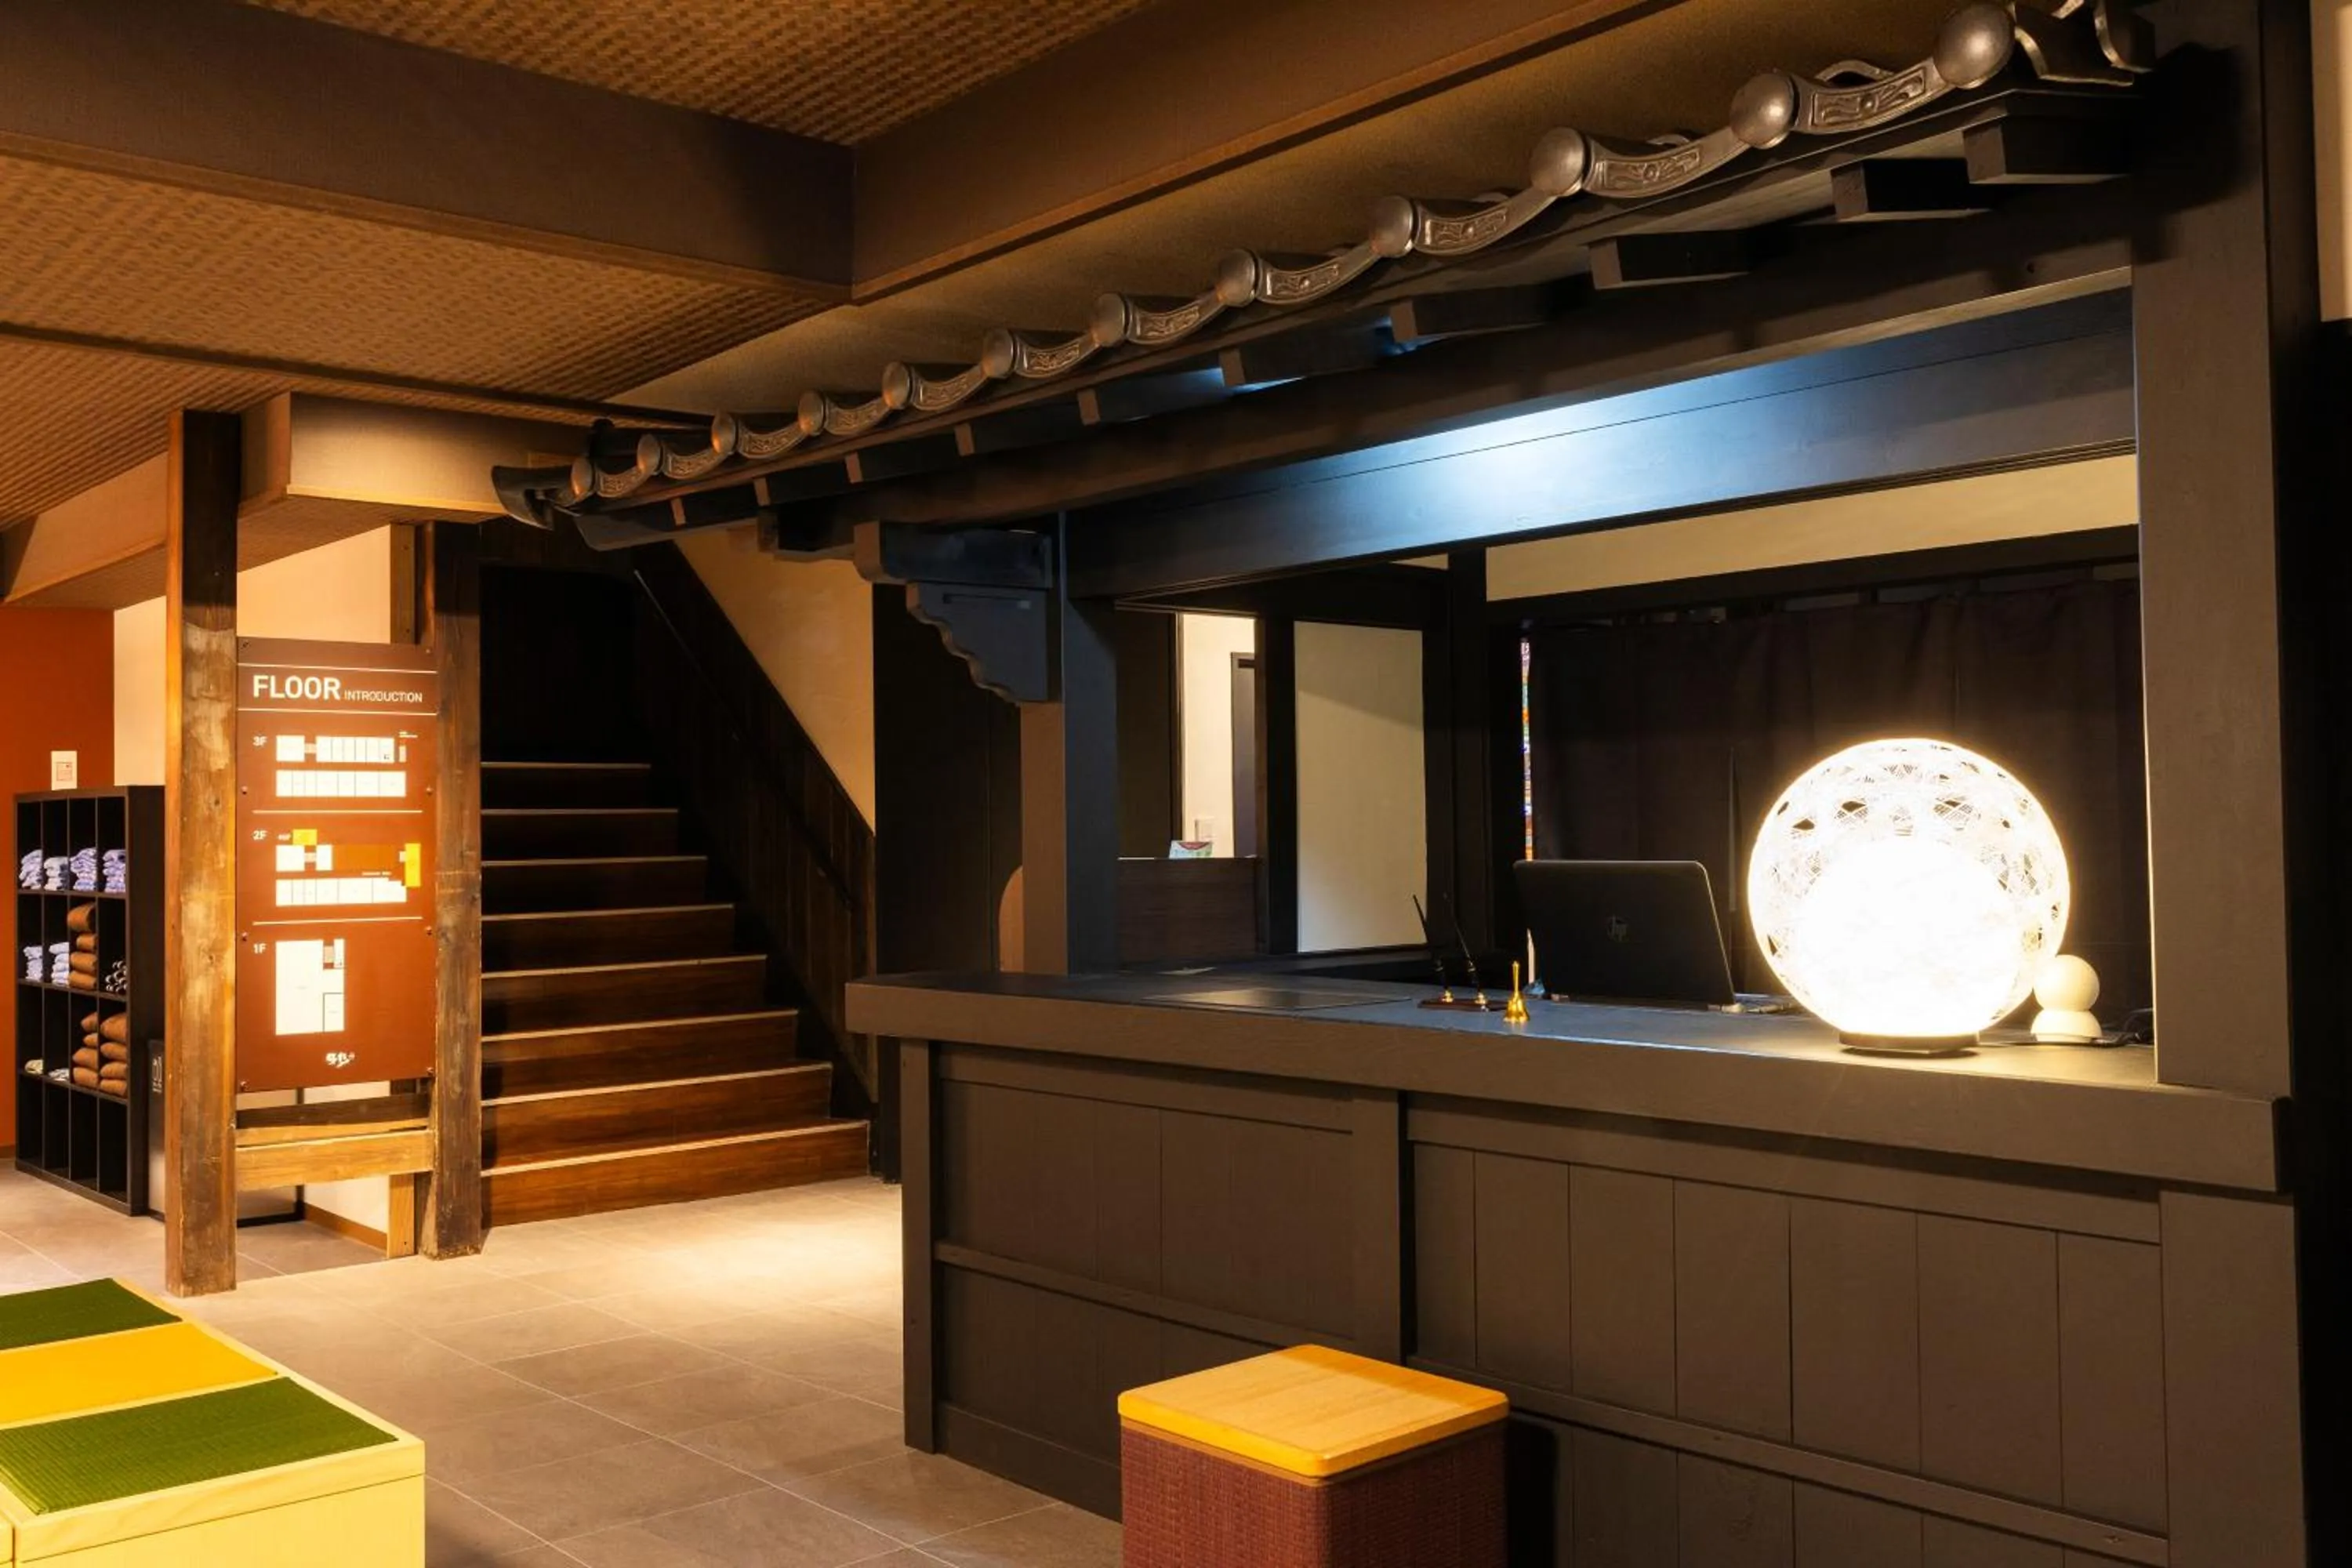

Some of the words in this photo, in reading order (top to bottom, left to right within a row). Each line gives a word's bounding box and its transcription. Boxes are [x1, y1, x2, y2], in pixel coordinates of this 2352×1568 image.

[252, 674, 341, 700] FLOOR
[344, 690, 423, 703] INTRODUCTION
[252, 736, 267, 746] 3F
[252, 829, 267, 841] 2F
[253, 943, 267, 954] 1F
